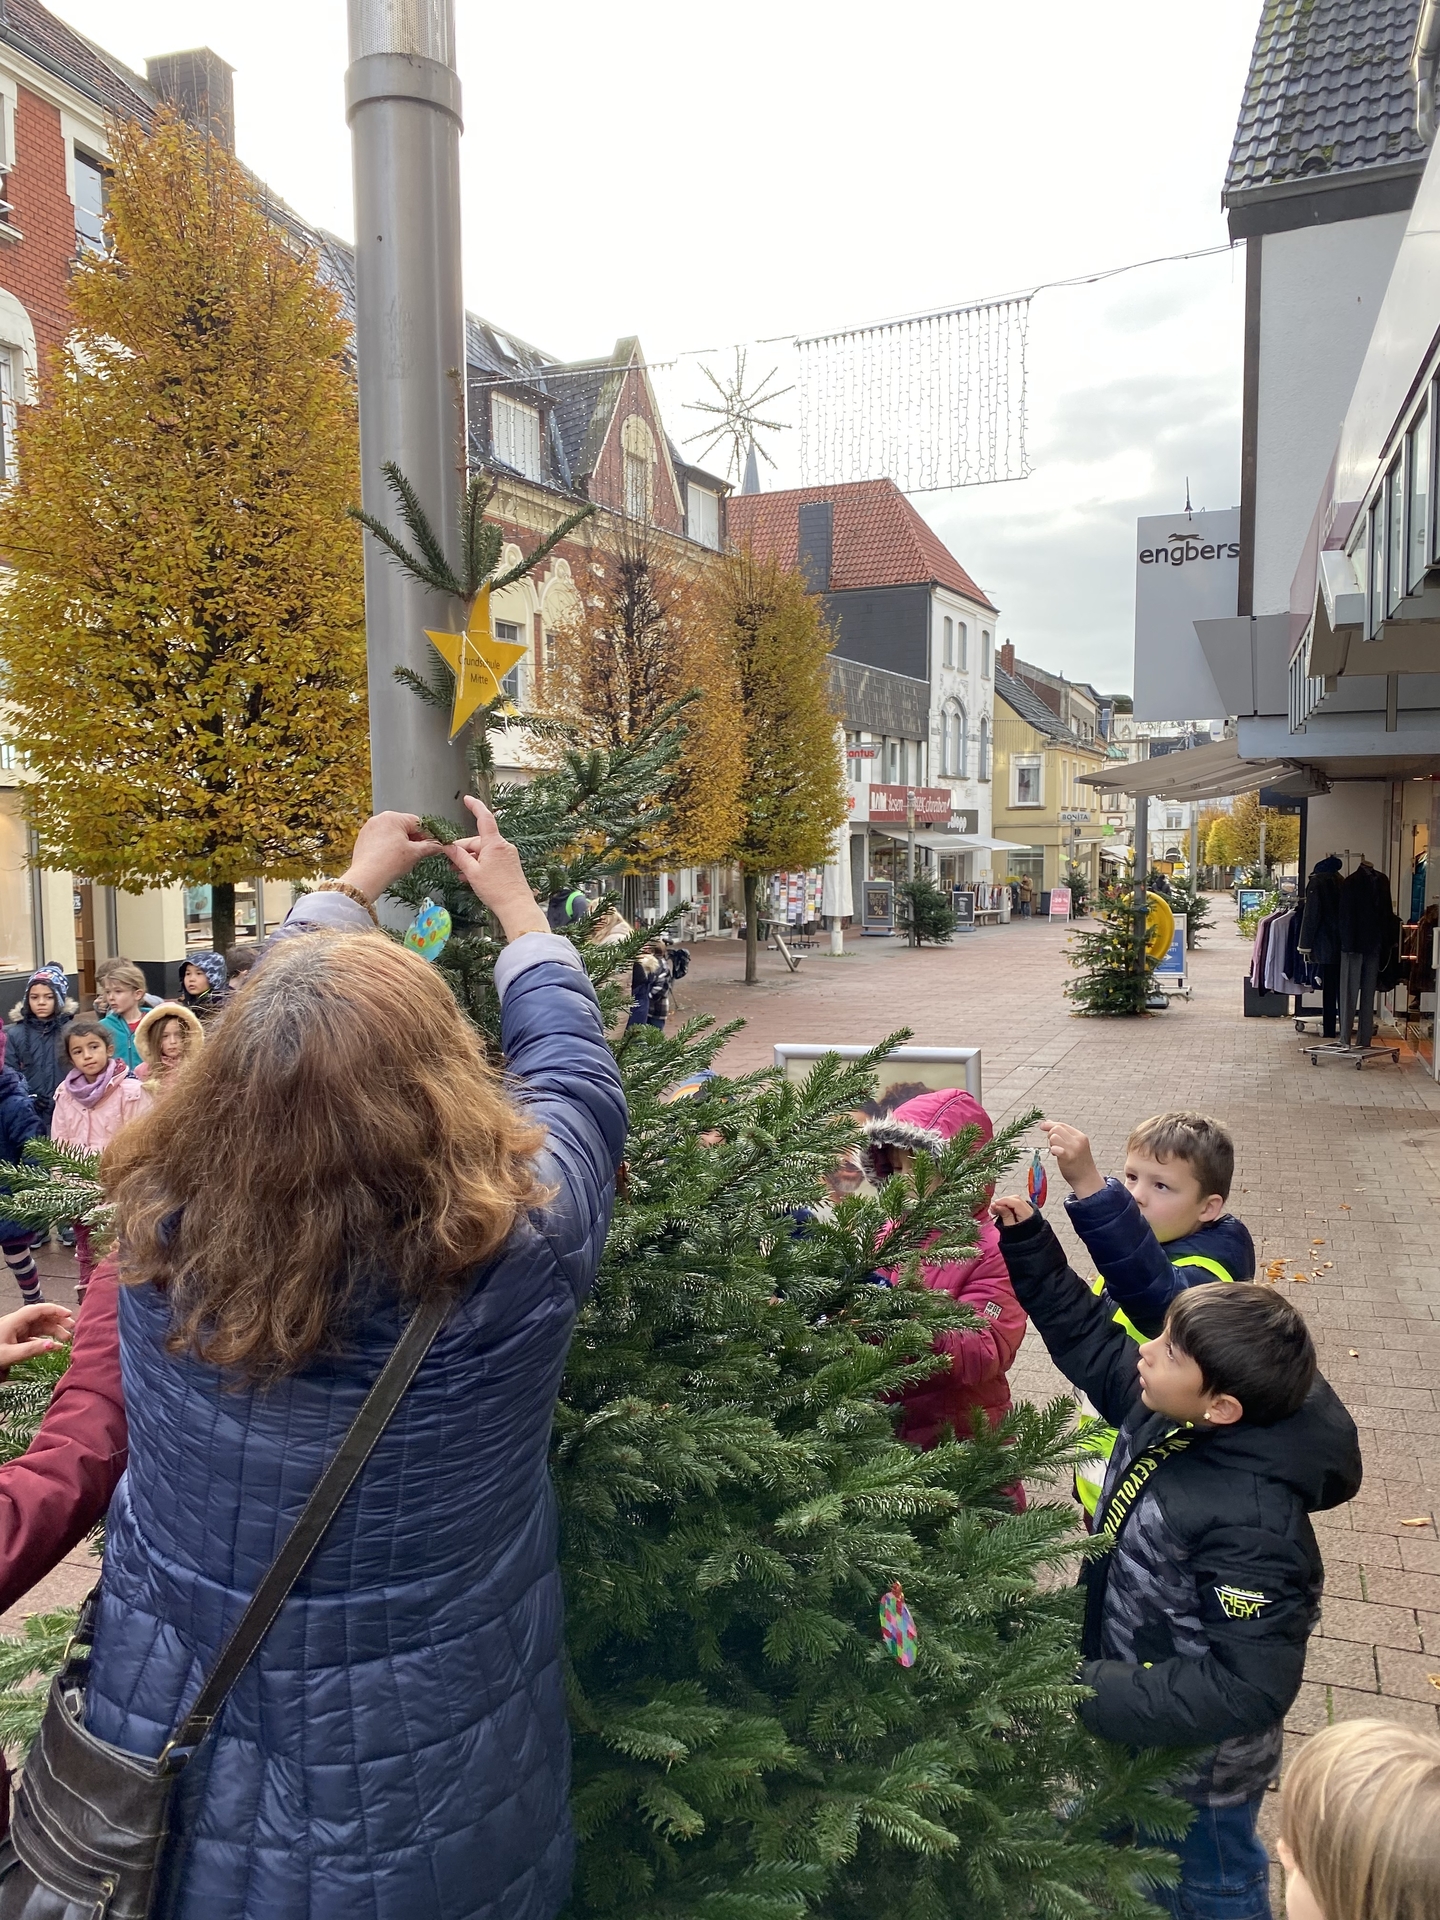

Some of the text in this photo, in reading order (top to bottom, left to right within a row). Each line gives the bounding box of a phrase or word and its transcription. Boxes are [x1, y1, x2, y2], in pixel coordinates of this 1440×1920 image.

[1139, 540, 1240, 566] engbers
[470, 673, 489, 685] Mitte
[1104, 1457, 1158, 1538] REVOLUTIO
